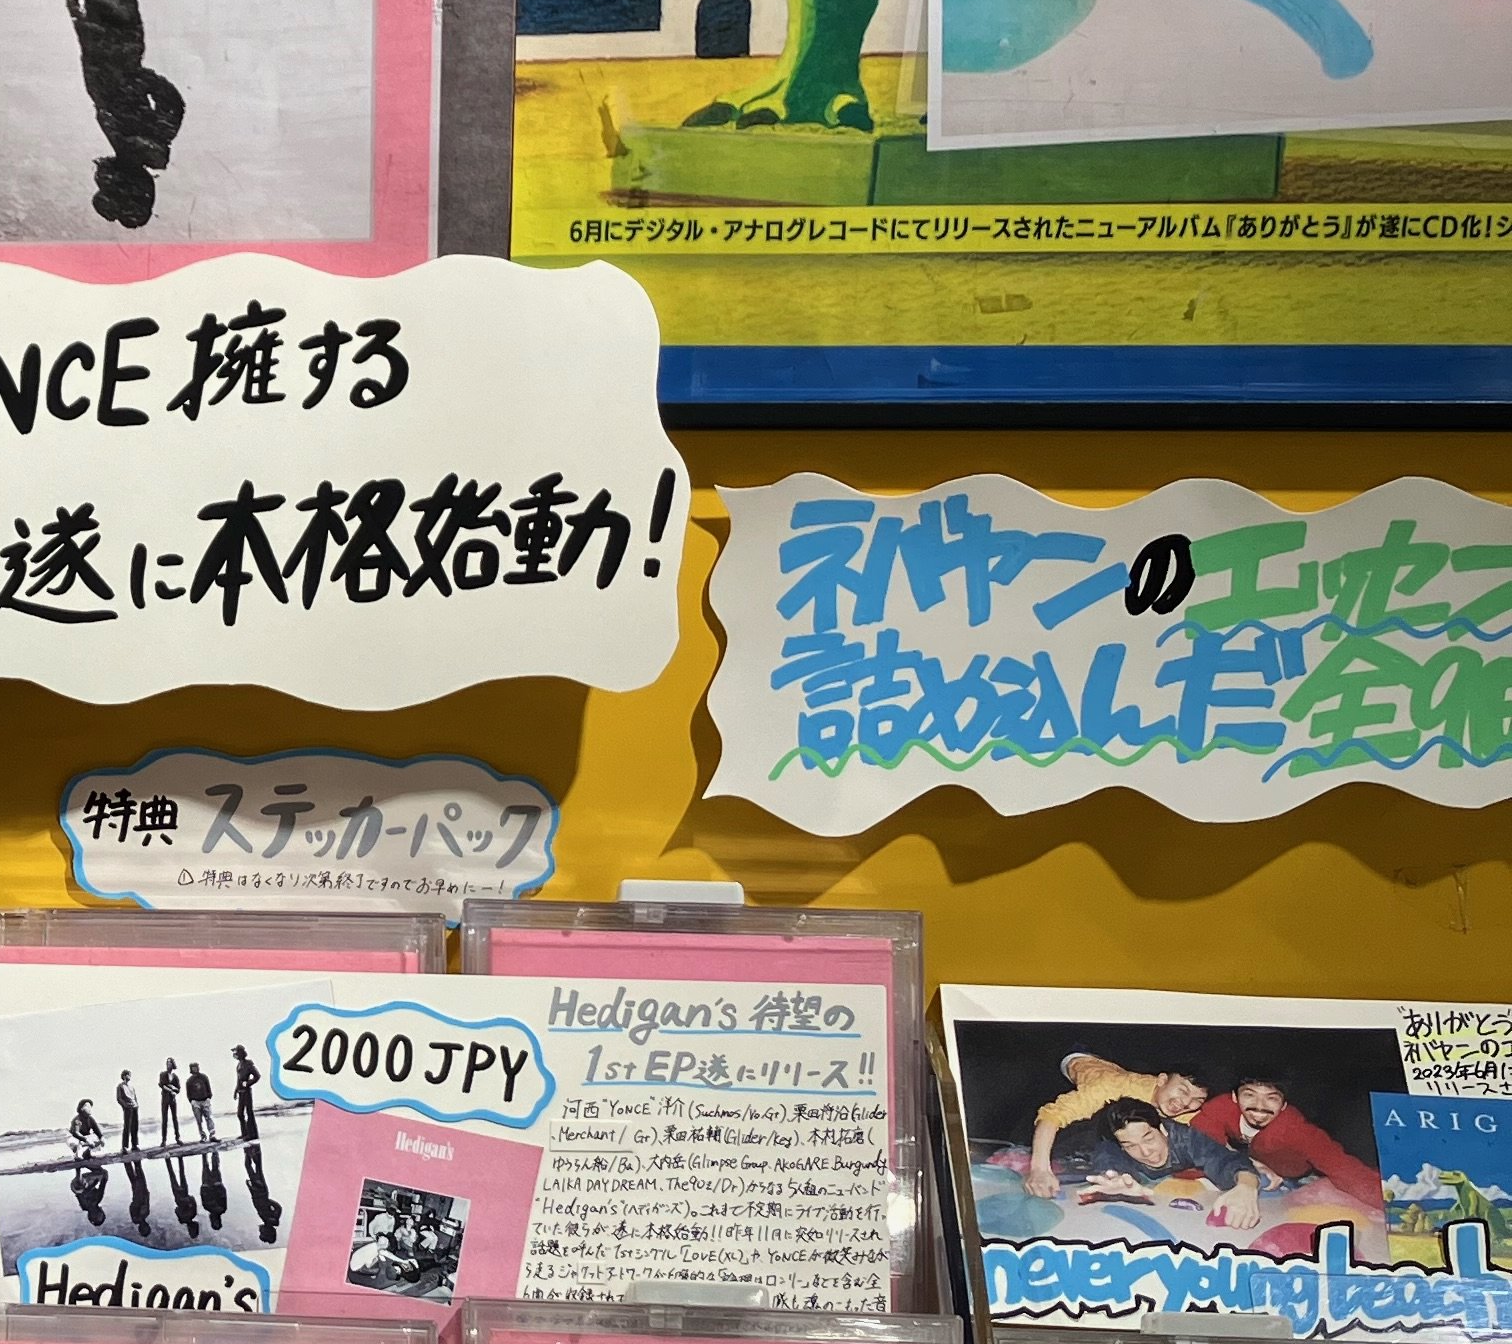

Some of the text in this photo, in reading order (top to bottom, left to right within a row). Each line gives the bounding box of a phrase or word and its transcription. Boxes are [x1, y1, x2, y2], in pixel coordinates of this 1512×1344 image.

[84, 783, 542, 868] 特典 ステッカーパック
[549, 986, 855, 1046] Hedigan's 待望の
[395, 1130, 456, 1163] Hedigan's
